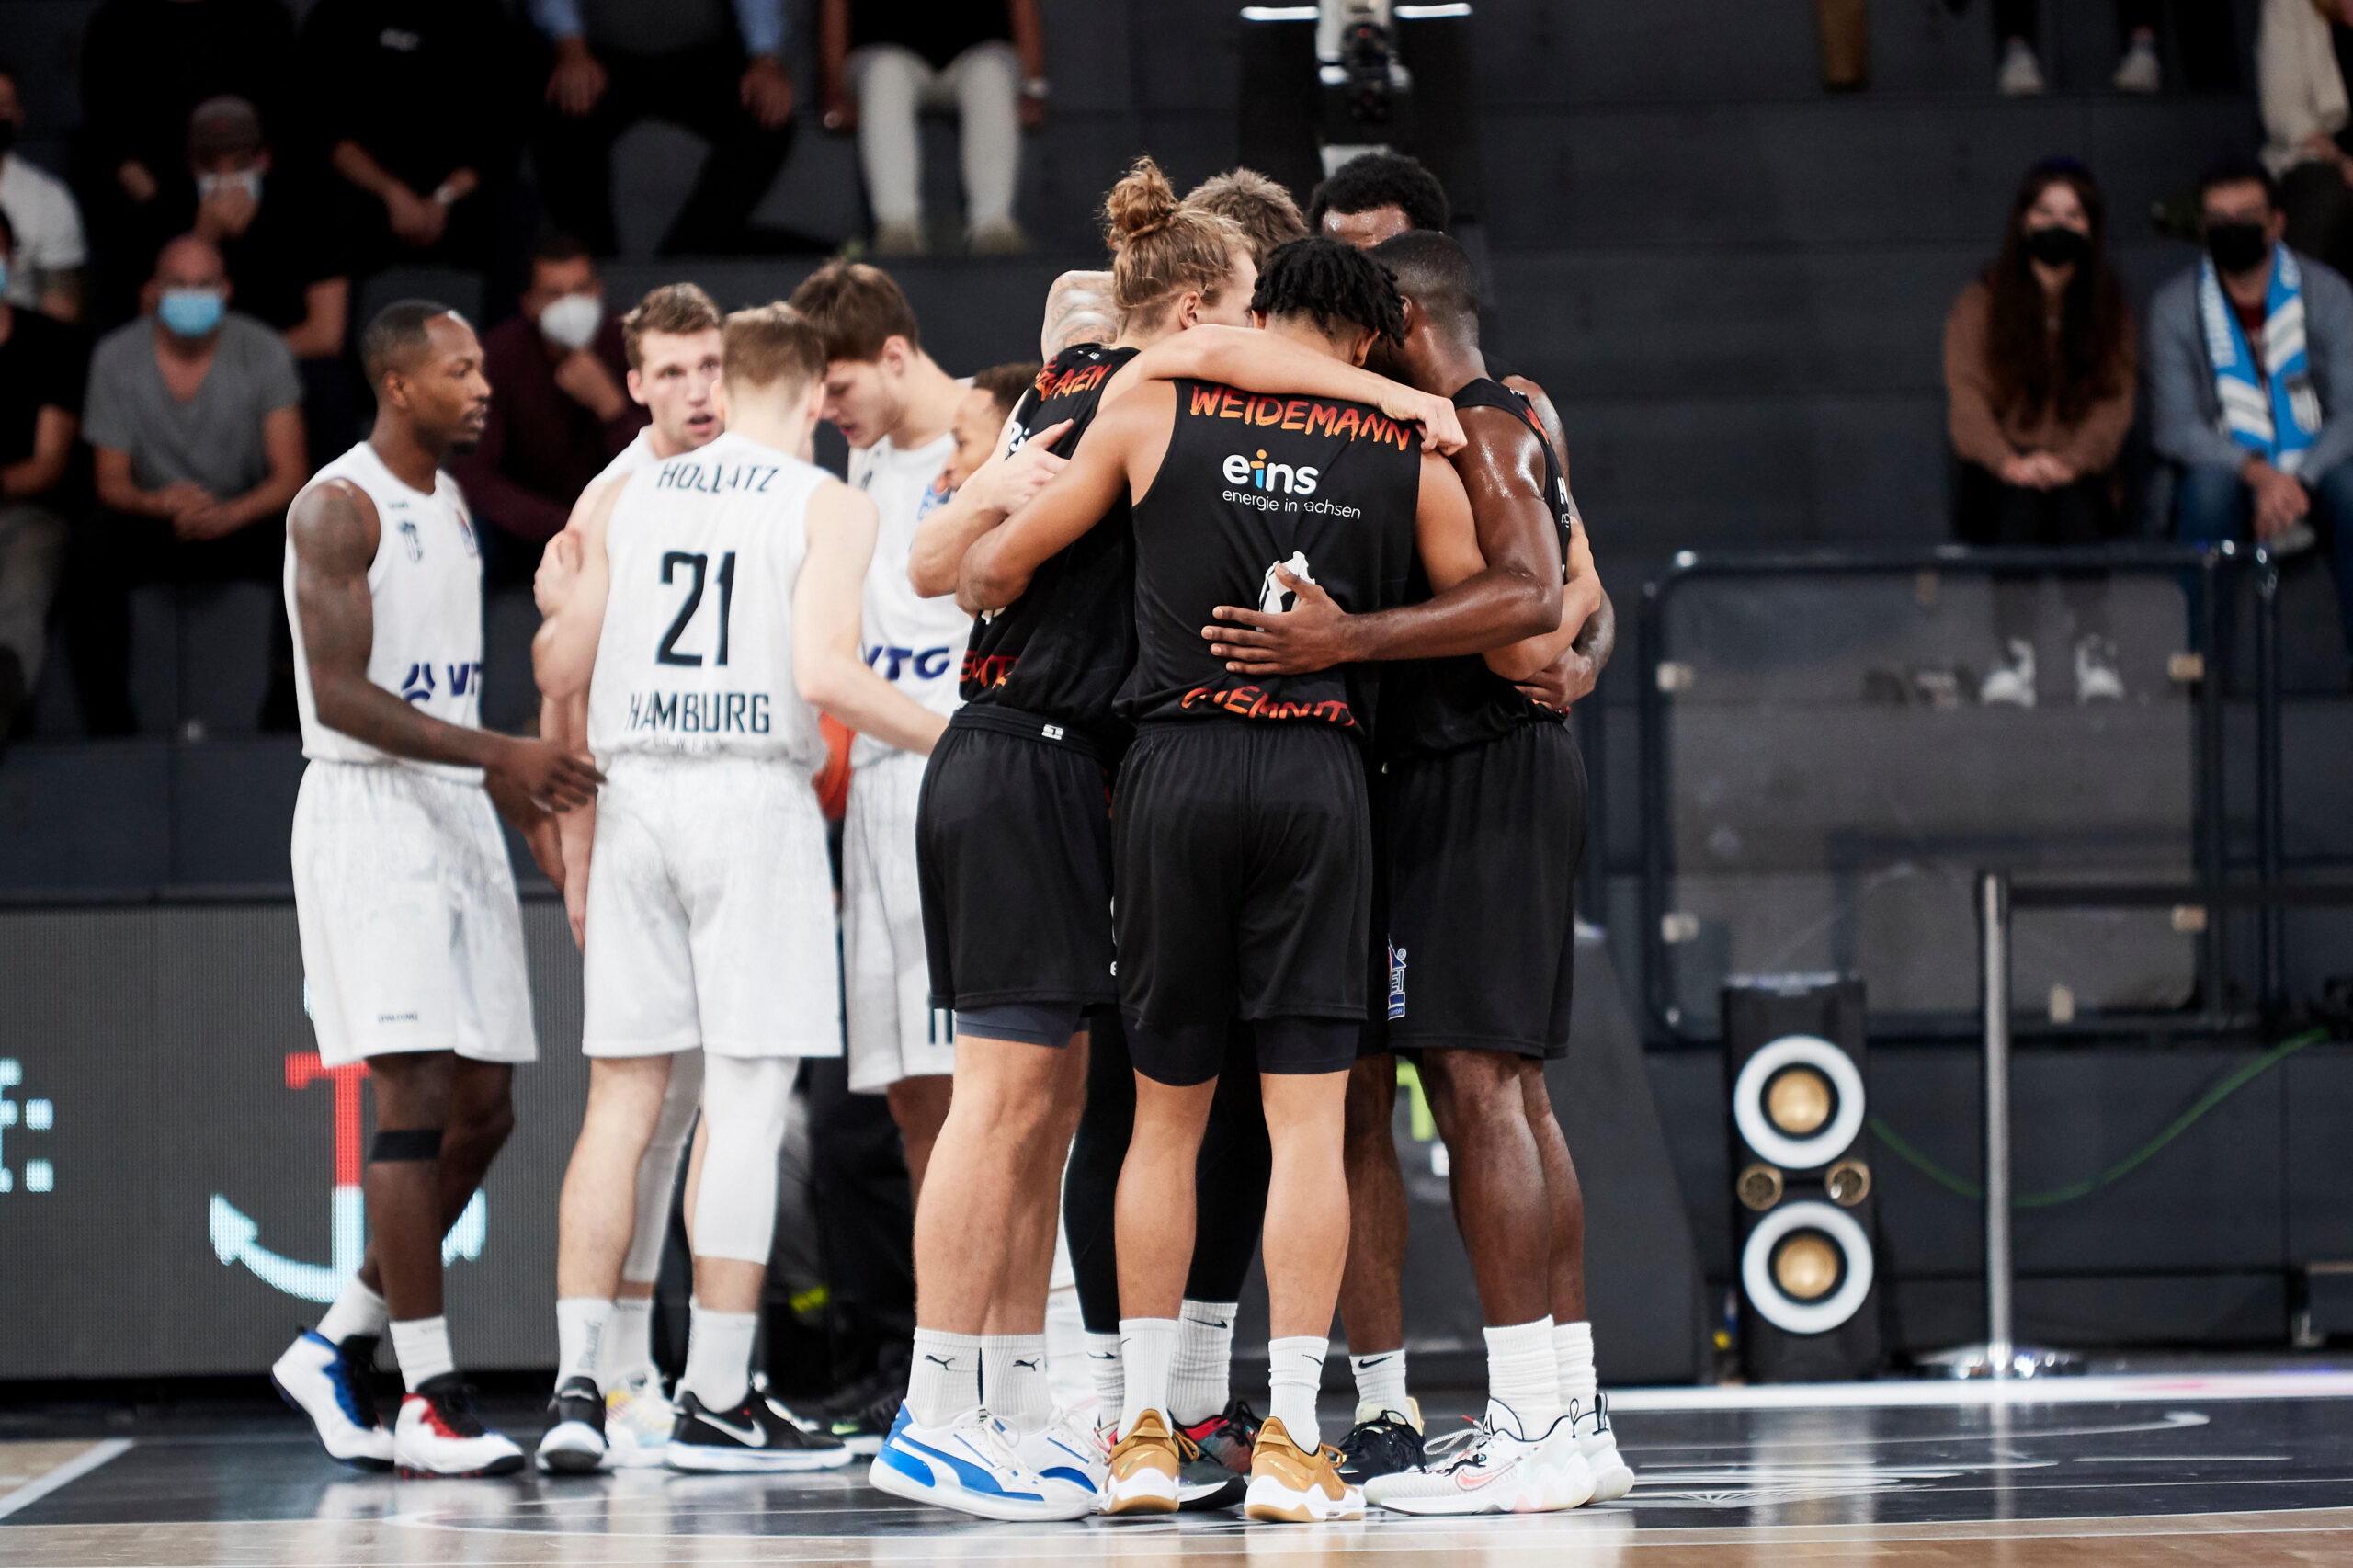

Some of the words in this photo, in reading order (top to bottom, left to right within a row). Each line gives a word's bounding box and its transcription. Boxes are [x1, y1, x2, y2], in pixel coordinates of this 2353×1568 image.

[1189, 385, 1411, 451] WEIDEMANN
[1222, 449, 1319, 494] eins
[1222, 489, 1279, 512] energie
[1284, 497, 1298, 513] in
[655, 550, 736, 667] 21
[625, 689, 770, 734] HAMBURG
